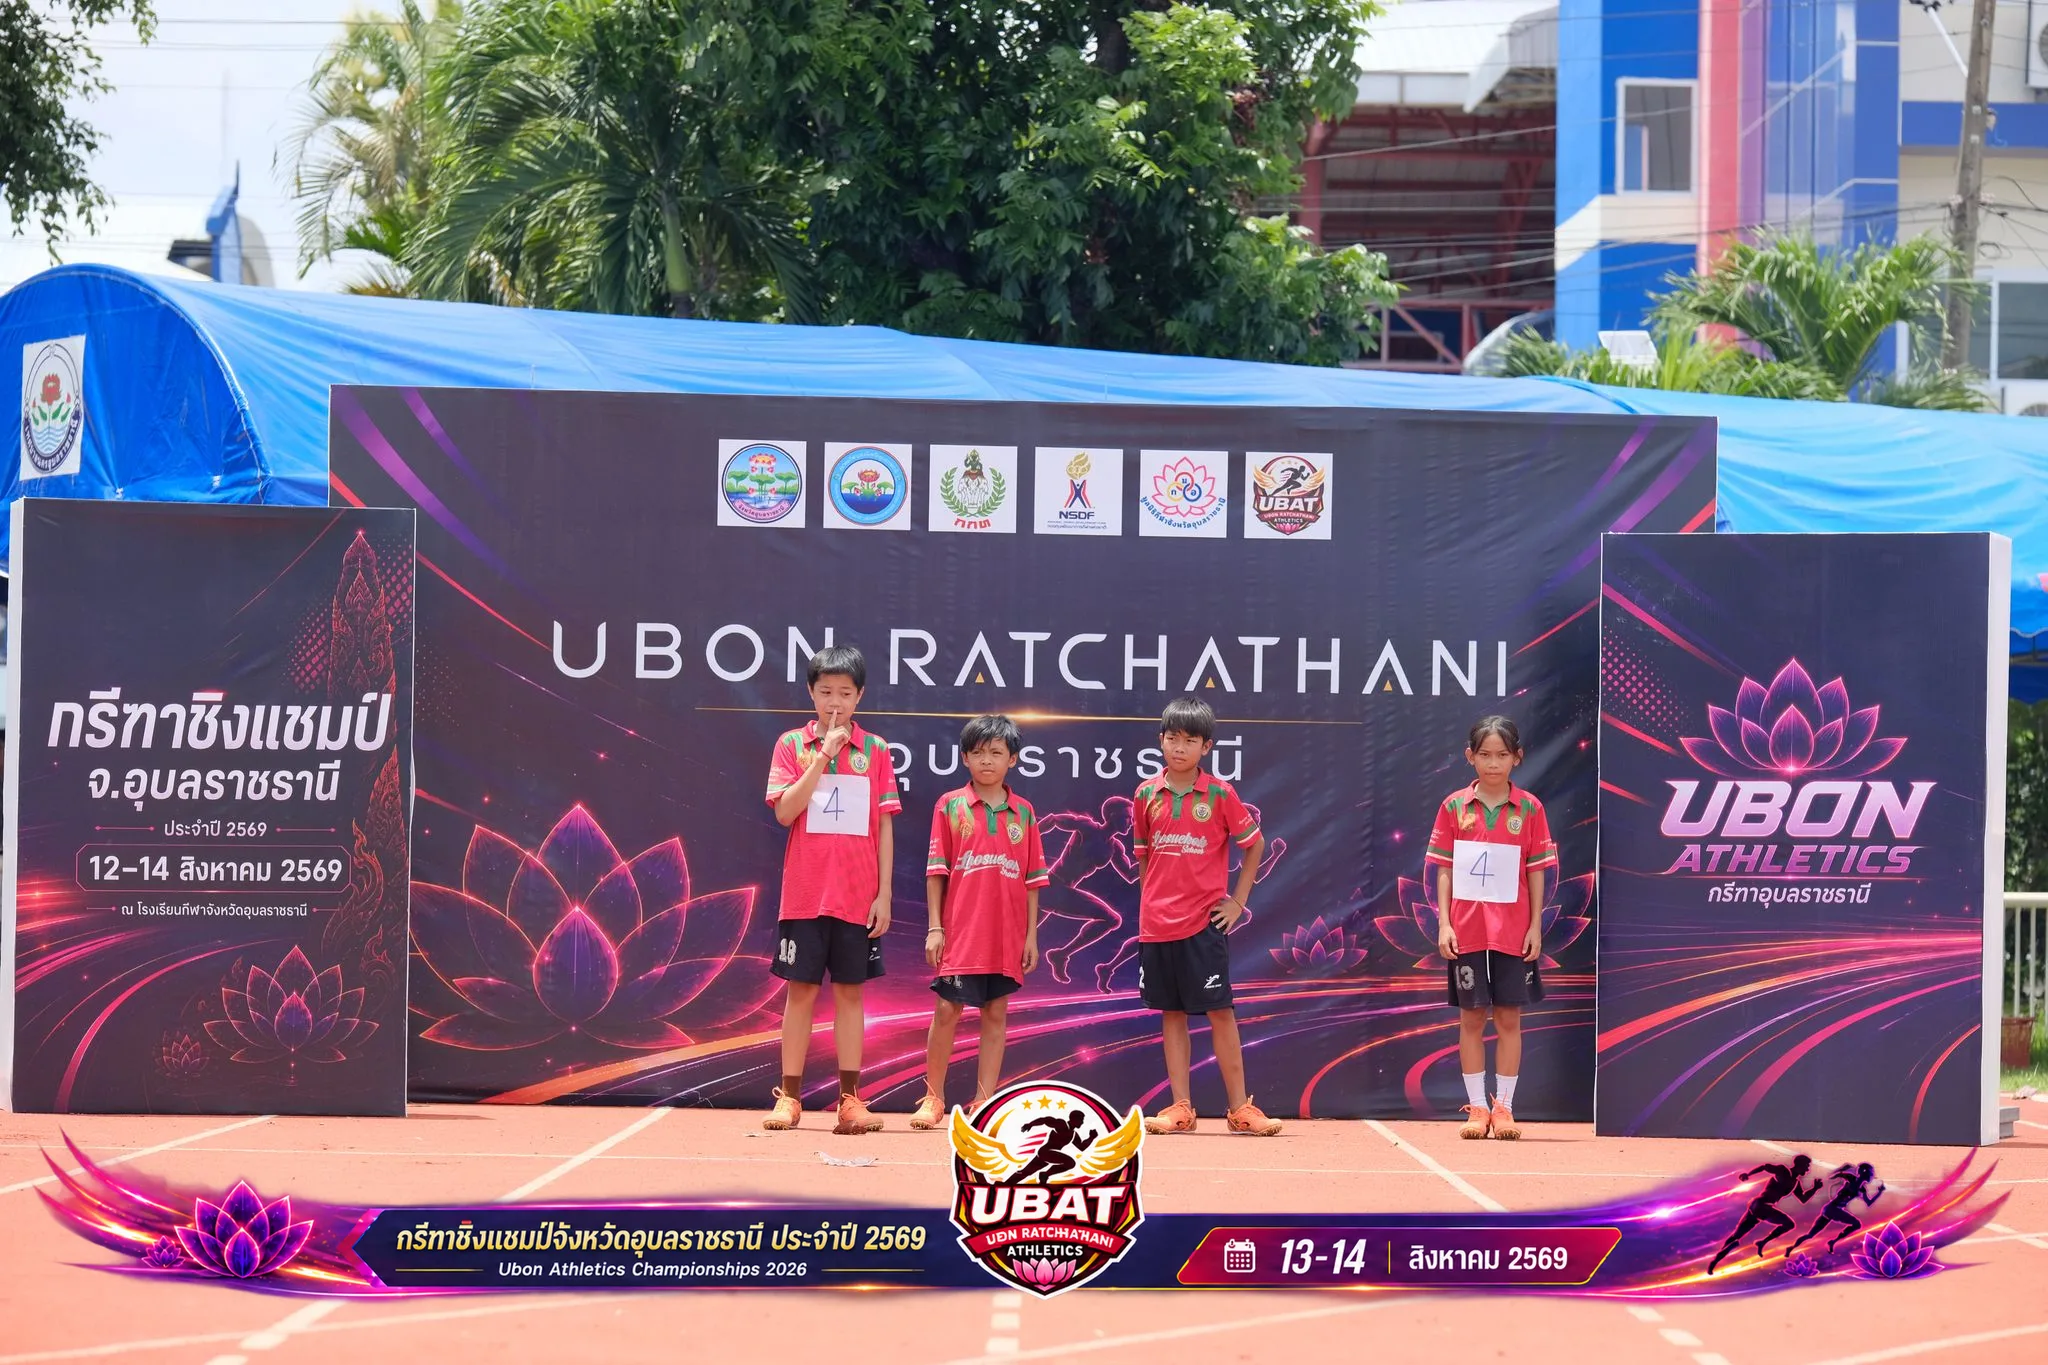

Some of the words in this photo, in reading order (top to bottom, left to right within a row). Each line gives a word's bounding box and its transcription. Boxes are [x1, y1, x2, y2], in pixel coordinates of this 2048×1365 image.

[1059, 511, 1095, 519] NSDF
[1259, 496, 1319, 513] UBAT
[552, 620, 834, 683] UBON
[889, 629, 1507, 697] RATCHATHANI
[47, 687, 392, 751] กรีฑาชิงแชมป์
[88, 760, 341, 811] จ.อุบลราชธานี
[823, 786, 845, 821] 4
[1661, 781, 1937, 839] UBON
[164, 818, 220, 837] ประจำปี
[226, 822, 267, 837] 2569
[179, 856, 271, 882] สิงหาคม
[281, 859, 342, 882] 2569
[1469, 850, 1494, 887] 4
[1668, 844, 1921, 874] ATHLETICS
[1707, 882, 1872, 909] กรีฑาอุบลราชธานี
[121, 903, 133, 916] ณ
[138, 901, 307, 920] โรงเรียนกีฬาจังหวัดอุบลราชธานี
[1456, 965, 1475, 991] 13
